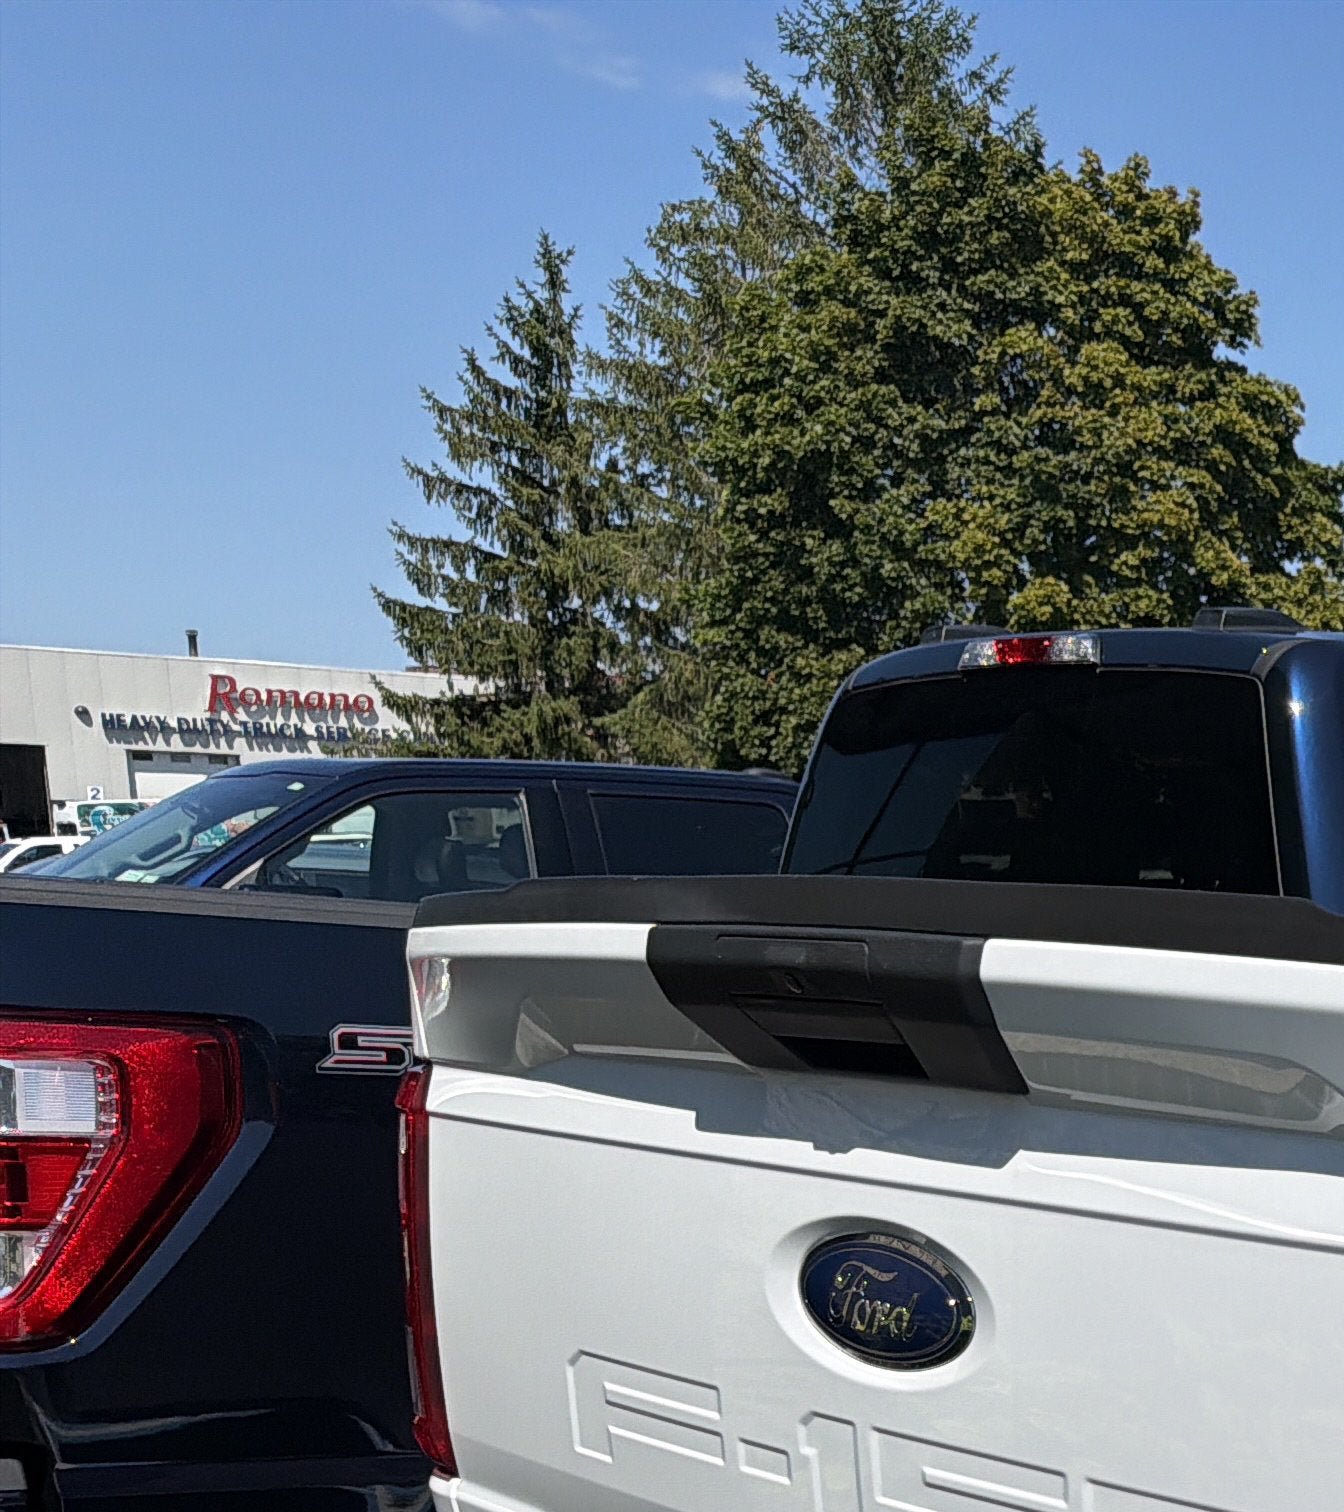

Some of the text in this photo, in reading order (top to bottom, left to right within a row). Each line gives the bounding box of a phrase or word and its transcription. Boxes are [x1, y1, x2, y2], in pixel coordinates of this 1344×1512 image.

[206, 674, 374, 714] Romano
[101, 712, 167, 733] HEAVY
[177, 716, 230, 737] DUTY
[239, 720, 309, 739] TRUCK
[90, 787, 102, 801] 2
[829, 1259, 920, 1342] Ford
